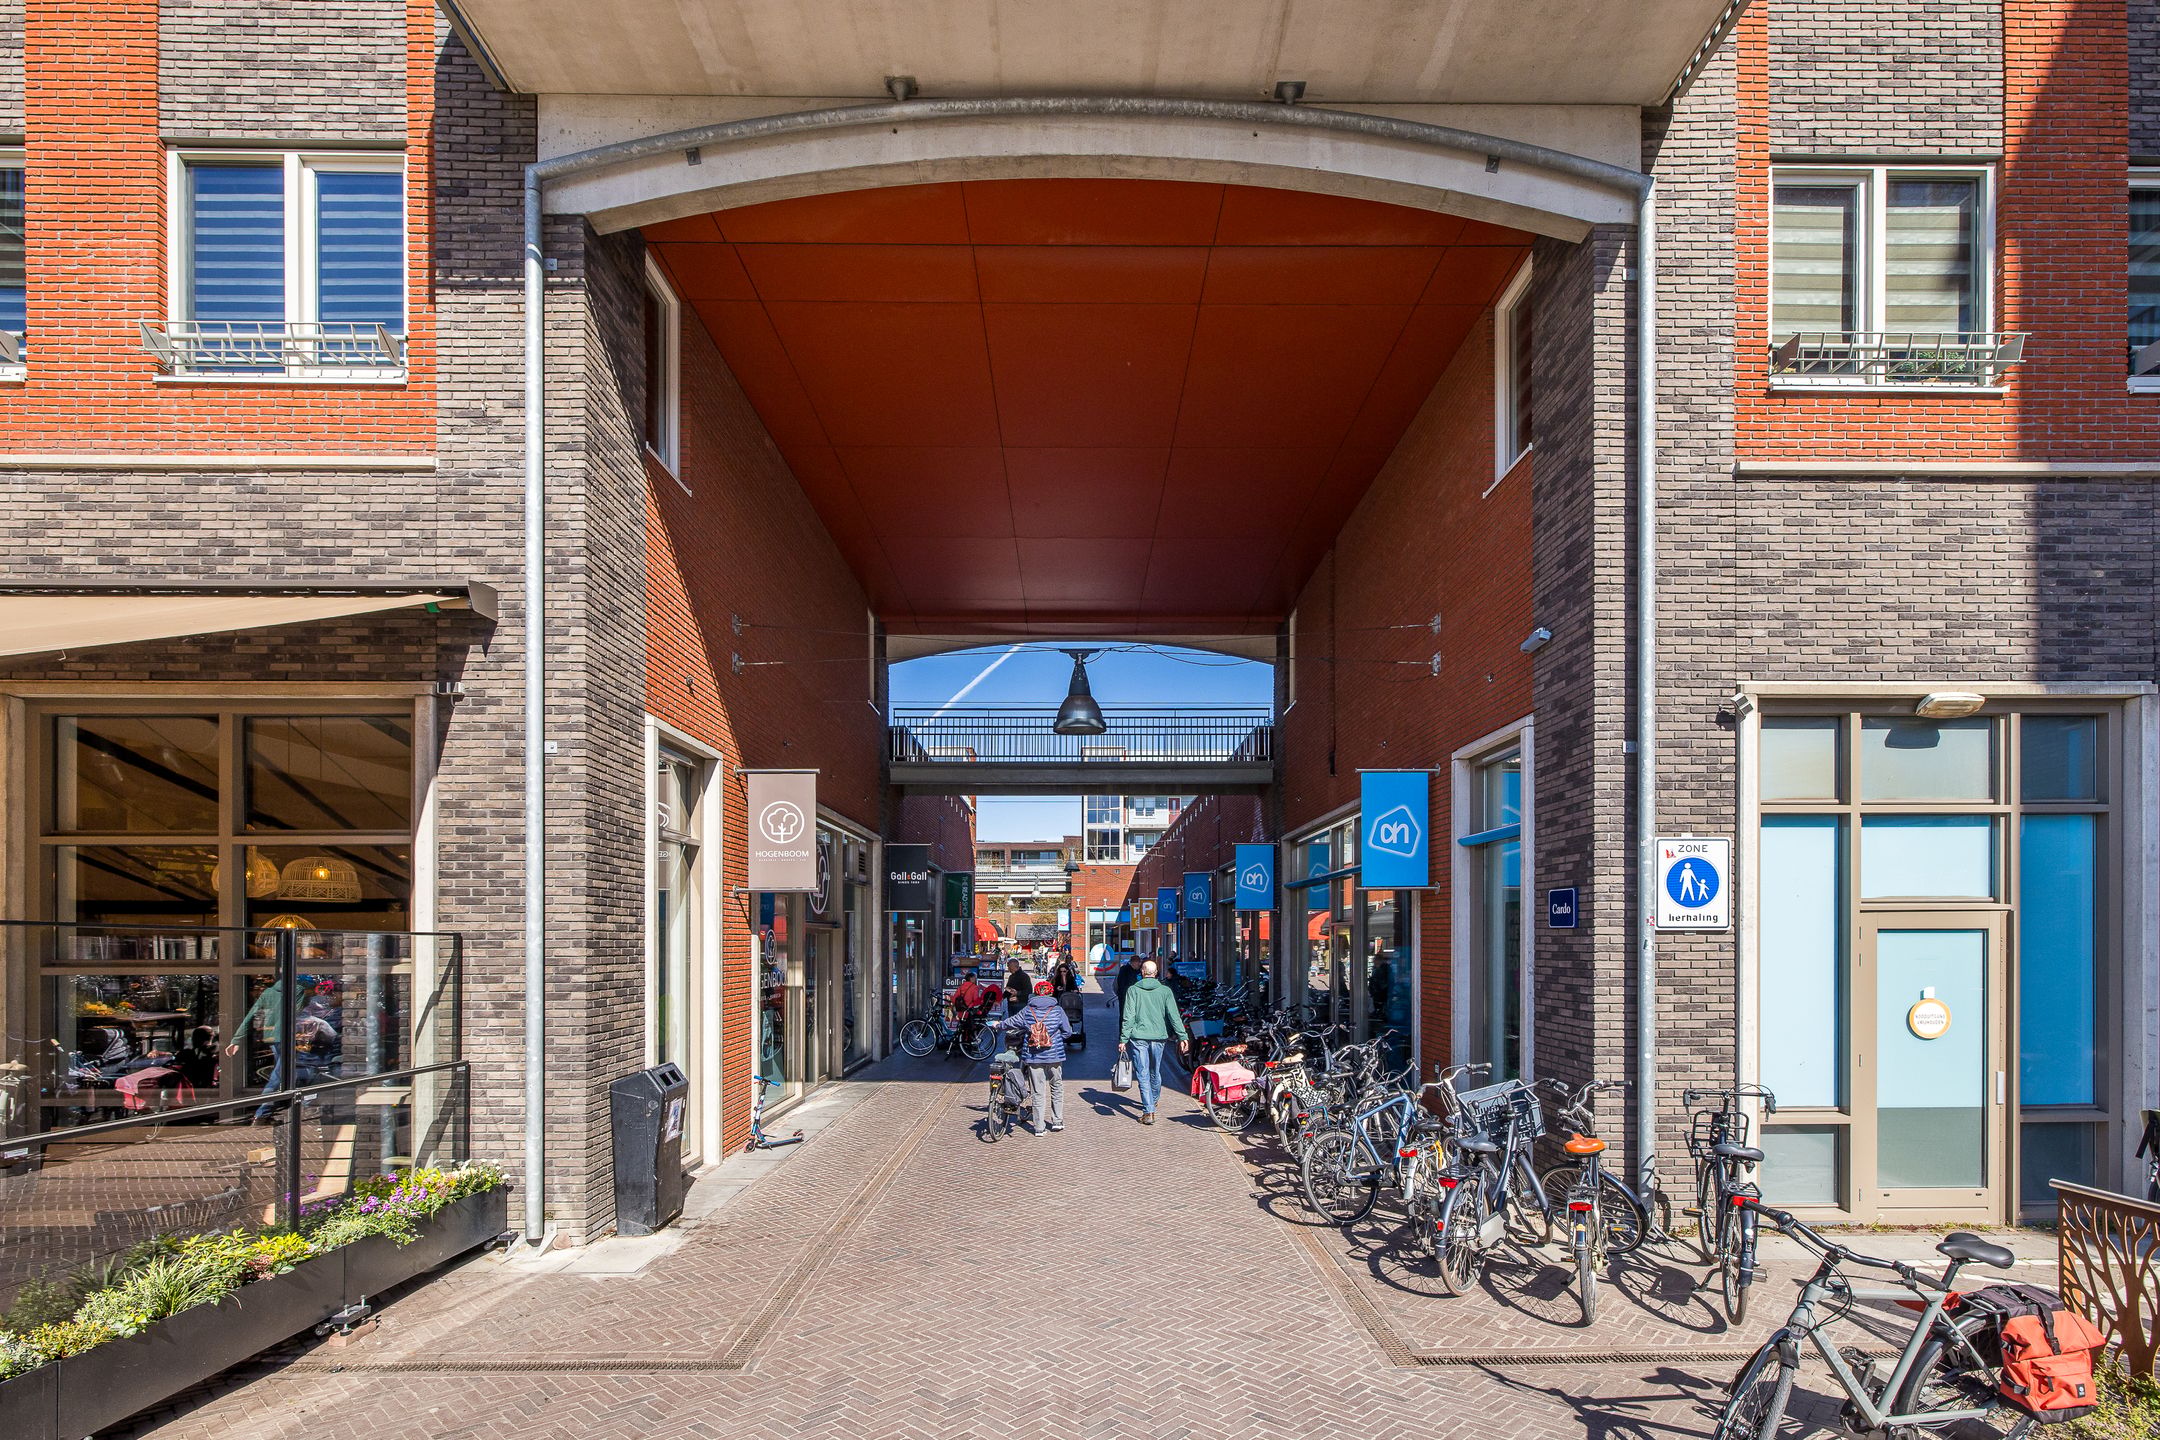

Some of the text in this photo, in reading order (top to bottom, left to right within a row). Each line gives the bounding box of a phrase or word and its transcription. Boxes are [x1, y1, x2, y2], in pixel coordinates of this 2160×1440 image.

[1678, 844, 1708, 853] ZONE
[755, 850, 809, 858] HOGENBOOM
[1142, 902, 1153, 916] P
[1552, 902, 1571, 914] Cardo
[1669, 913, 1718, 923] herhaling
